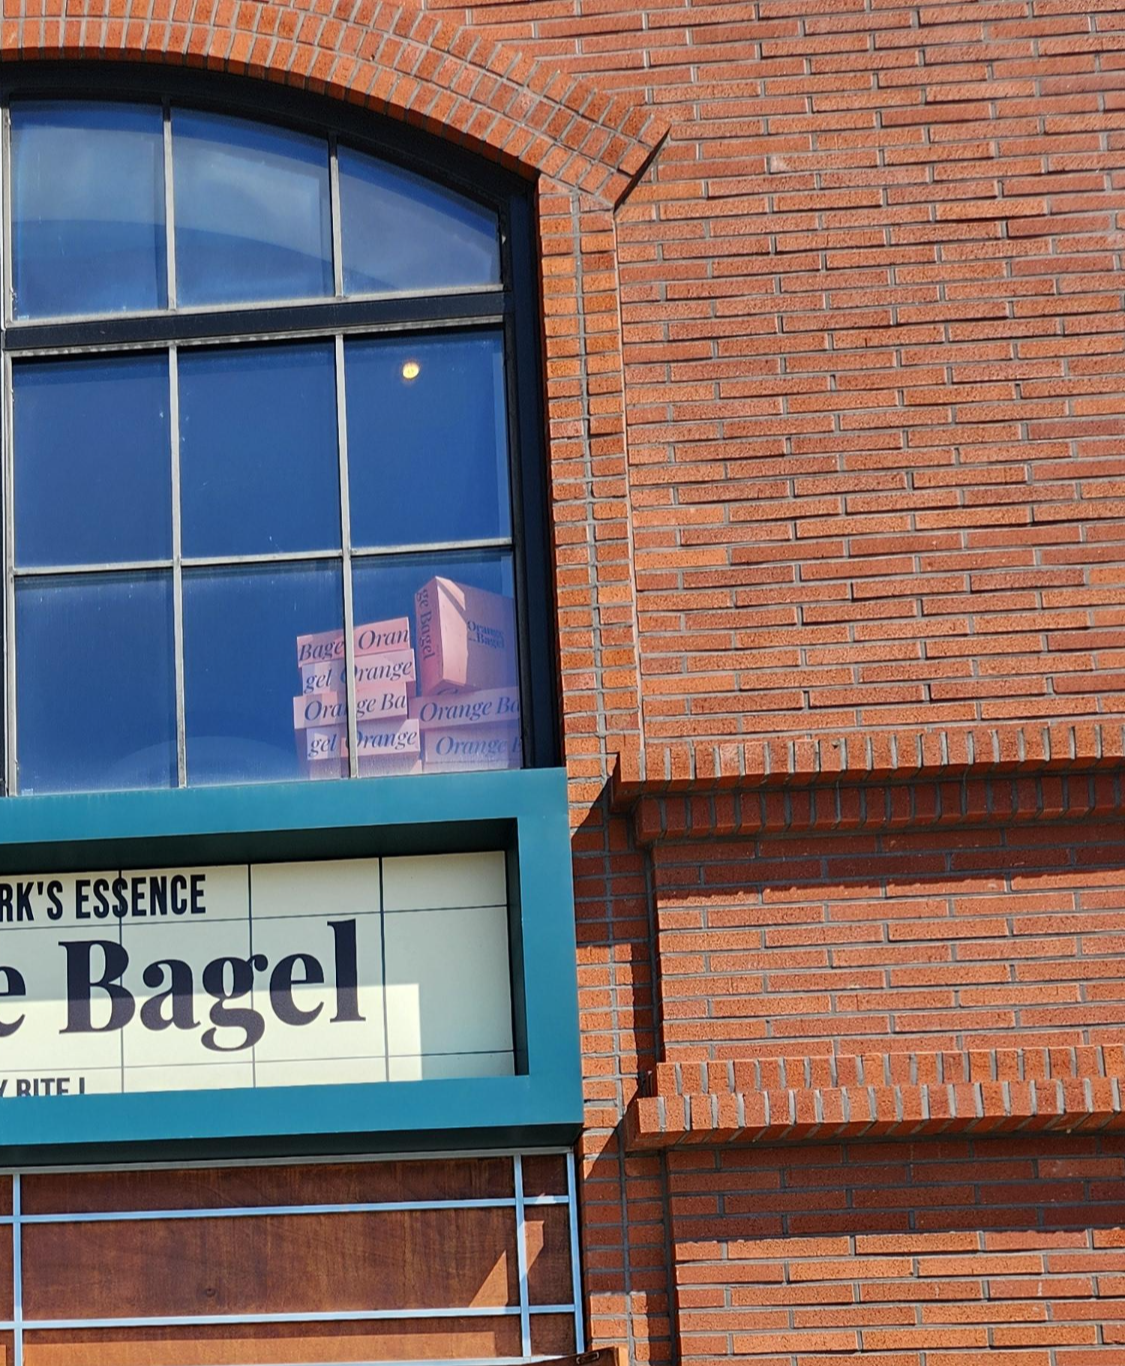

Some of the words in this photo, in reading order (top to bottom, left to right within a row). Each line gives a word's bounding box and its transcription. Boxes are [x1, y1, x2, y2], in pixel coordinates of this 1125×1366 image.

[419, 610, 435, 660] Bagel
[299, 640, 344, 660] Bage
[303, 668, 332, 694] gel
[305, 698, 376, 721] Orage
[420, 701, 492, 722] Orange
[308, 734, 337, 757] gel
[436, 736, 507, 757] Orange
[76, 874, 206, 919] ESSENCE
[58, 919, 366, 1052] Bagel
[16, 1077, 70, 1097] BITE
